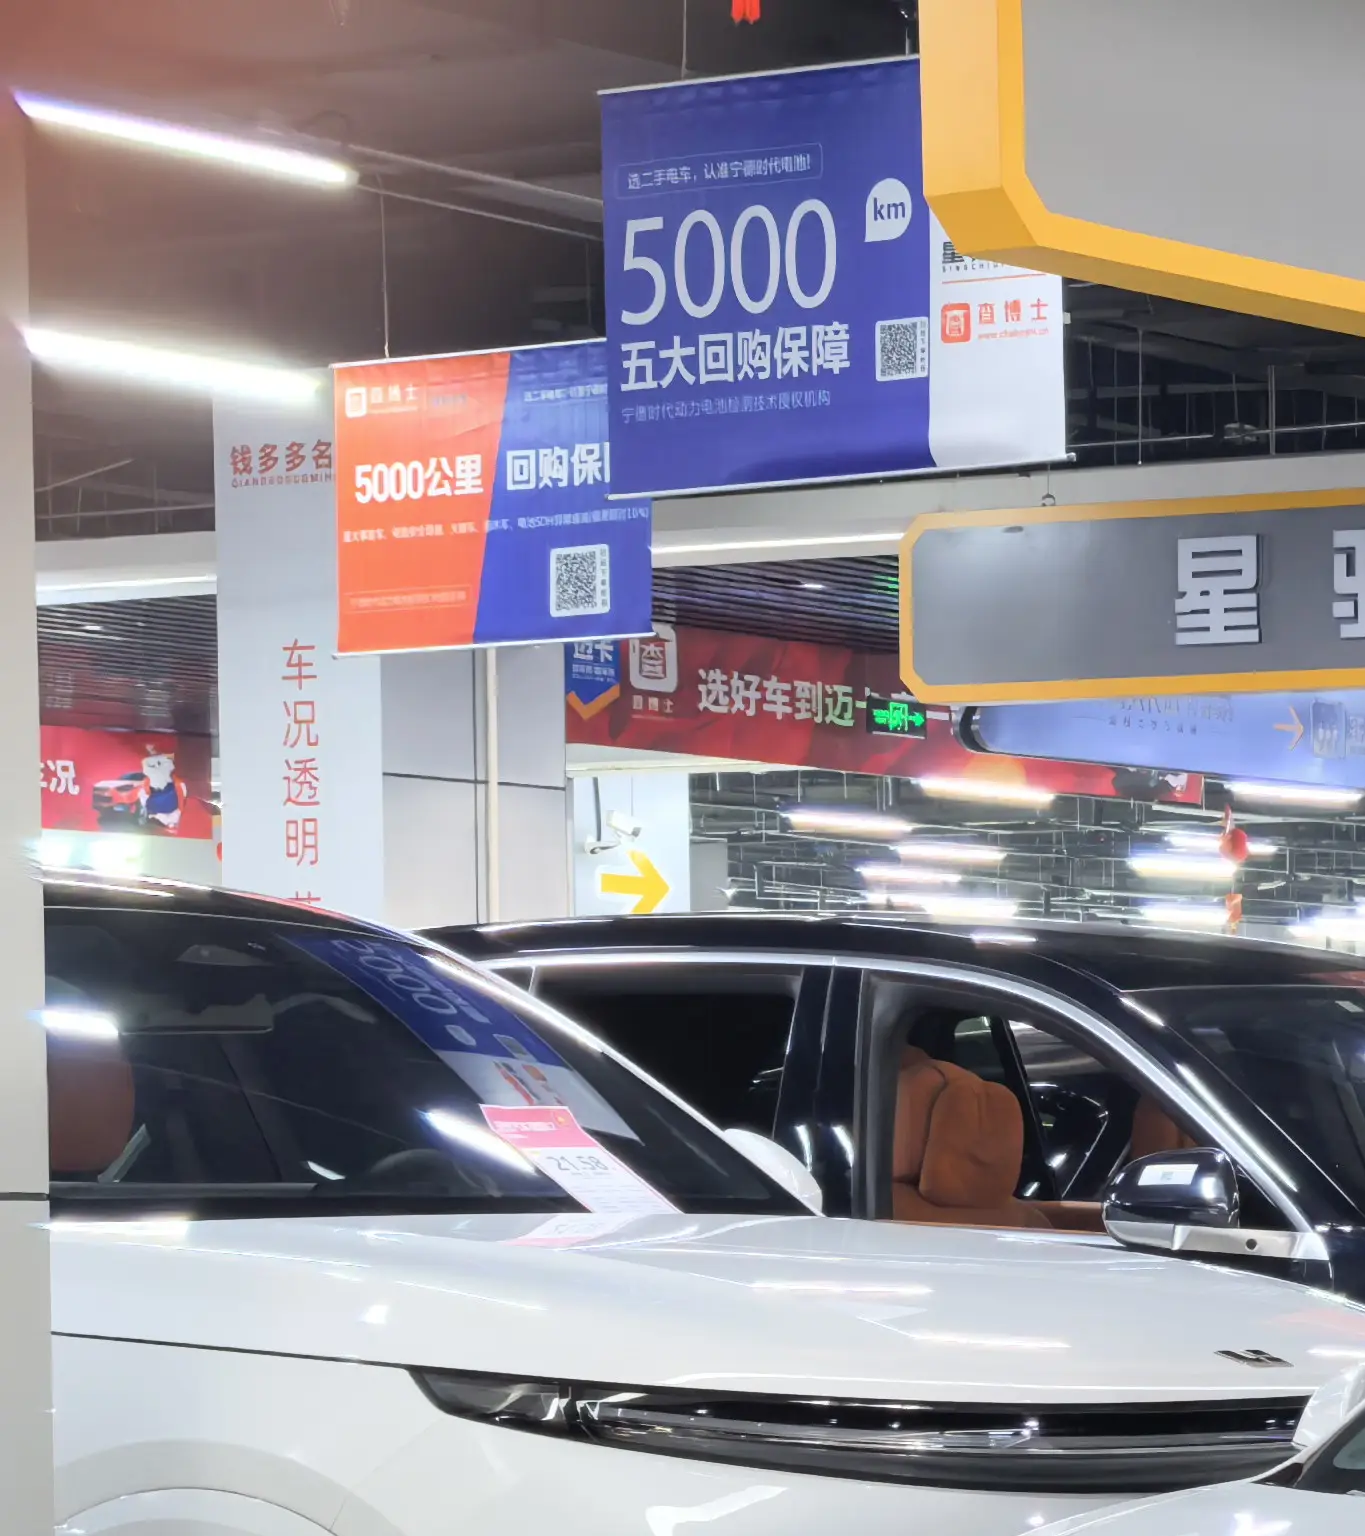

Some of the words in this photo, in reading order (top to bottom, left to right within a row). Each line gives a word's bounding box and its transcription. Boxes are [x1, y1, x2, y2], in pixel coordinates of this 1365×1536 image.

[873, 197, 906, 222] km
[620, 198, 838, 326] 5000
[977, 297, 1049, 325] 查博士
[620, 320, 850, 392] 五大回购保障
[355, 453, 484, 505] 5000公里
[281, 638, 321, 905] 车况透明
